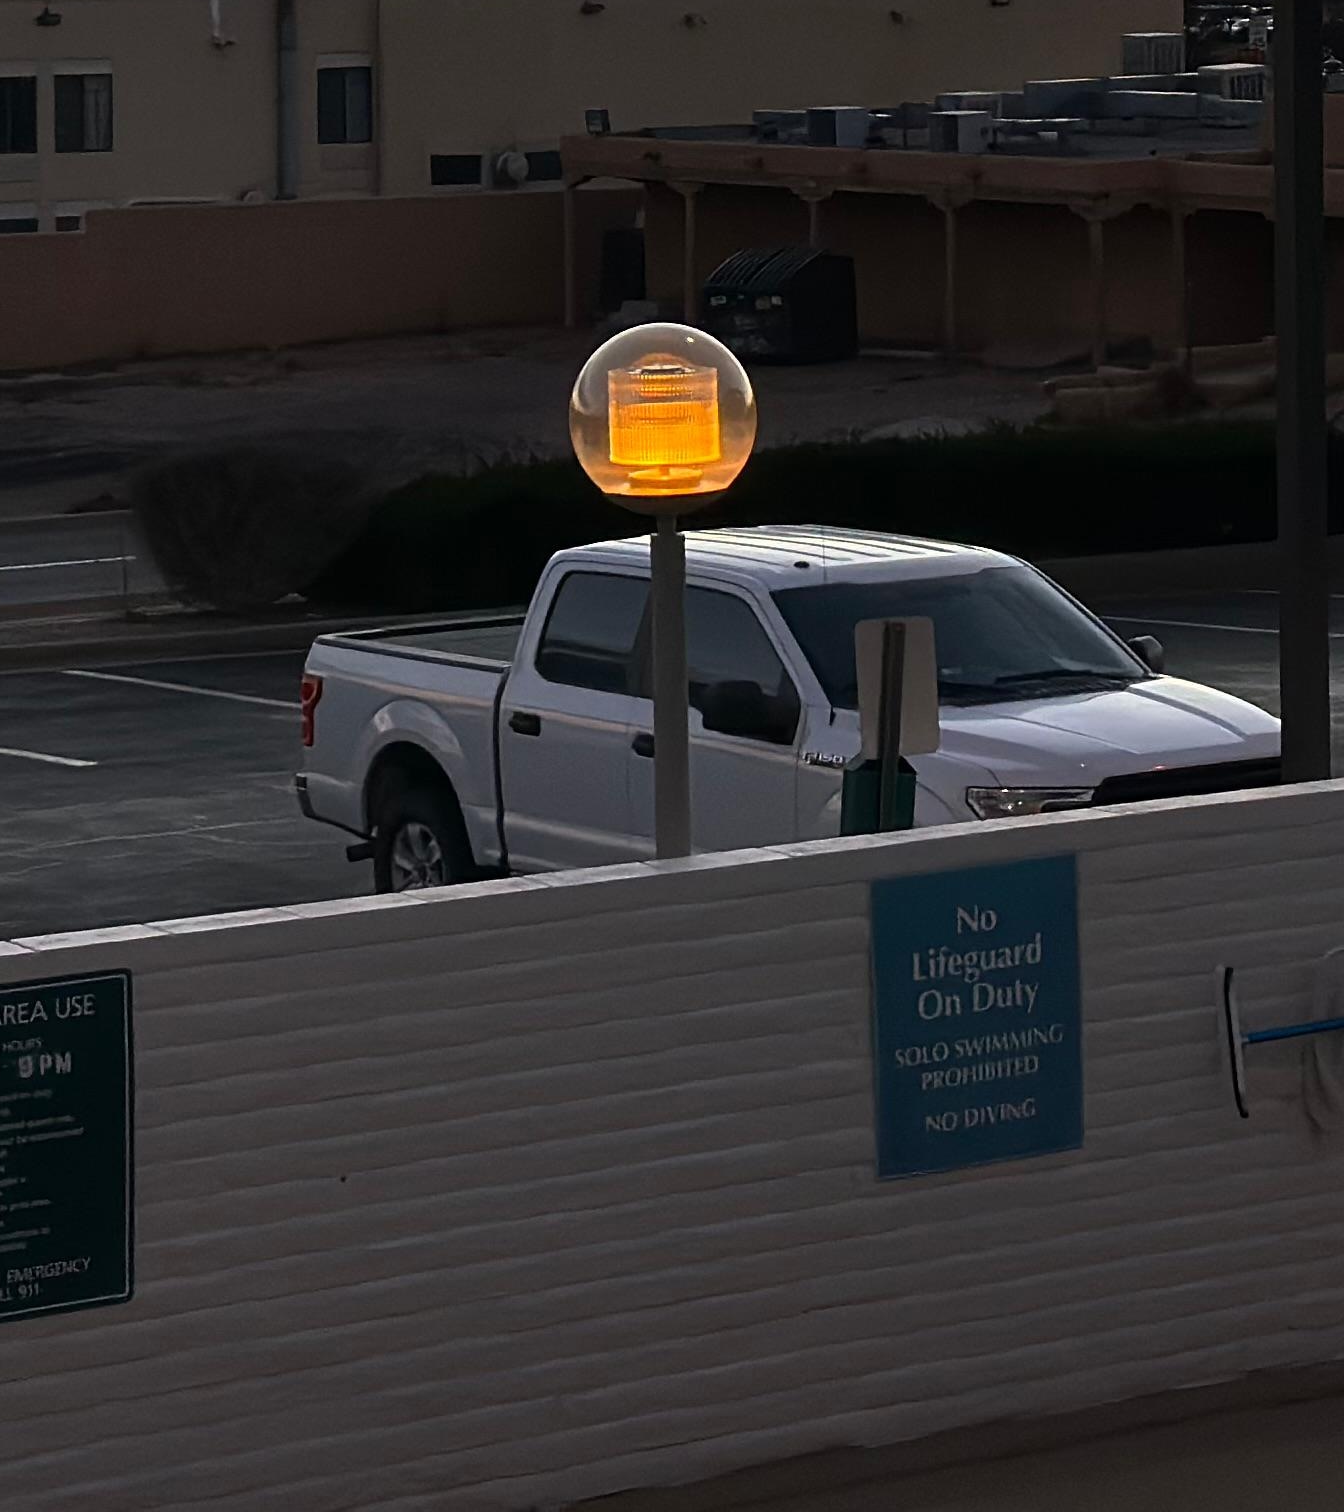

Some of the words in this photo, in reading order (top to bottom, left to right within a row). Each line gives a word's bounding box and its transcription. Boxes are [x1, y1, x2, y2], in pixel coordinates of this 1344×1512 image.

[956, 904, 998, 935] No
[912, 932, 1042, 984] Lifeguard
[56, 993, 96, 1019] USE
[918, 989, 961, 1020] On
[972, 978, 1039, 1014] Duty
[2, 1037, 43, 1053] HOURS
[895, 1041, 949, 1068] SOLO
[954, 1023, 1064, 1058] SWIMMING
[921, 1054, 1040, 1090] PROHIBITED
[925, 1111, 958, 1133] NO
[964, 1097, 1036, 1128] DIVING
[6, 1255, 92, 1285] EMERGENCY
[17, 1281, 40, 1299] 911
